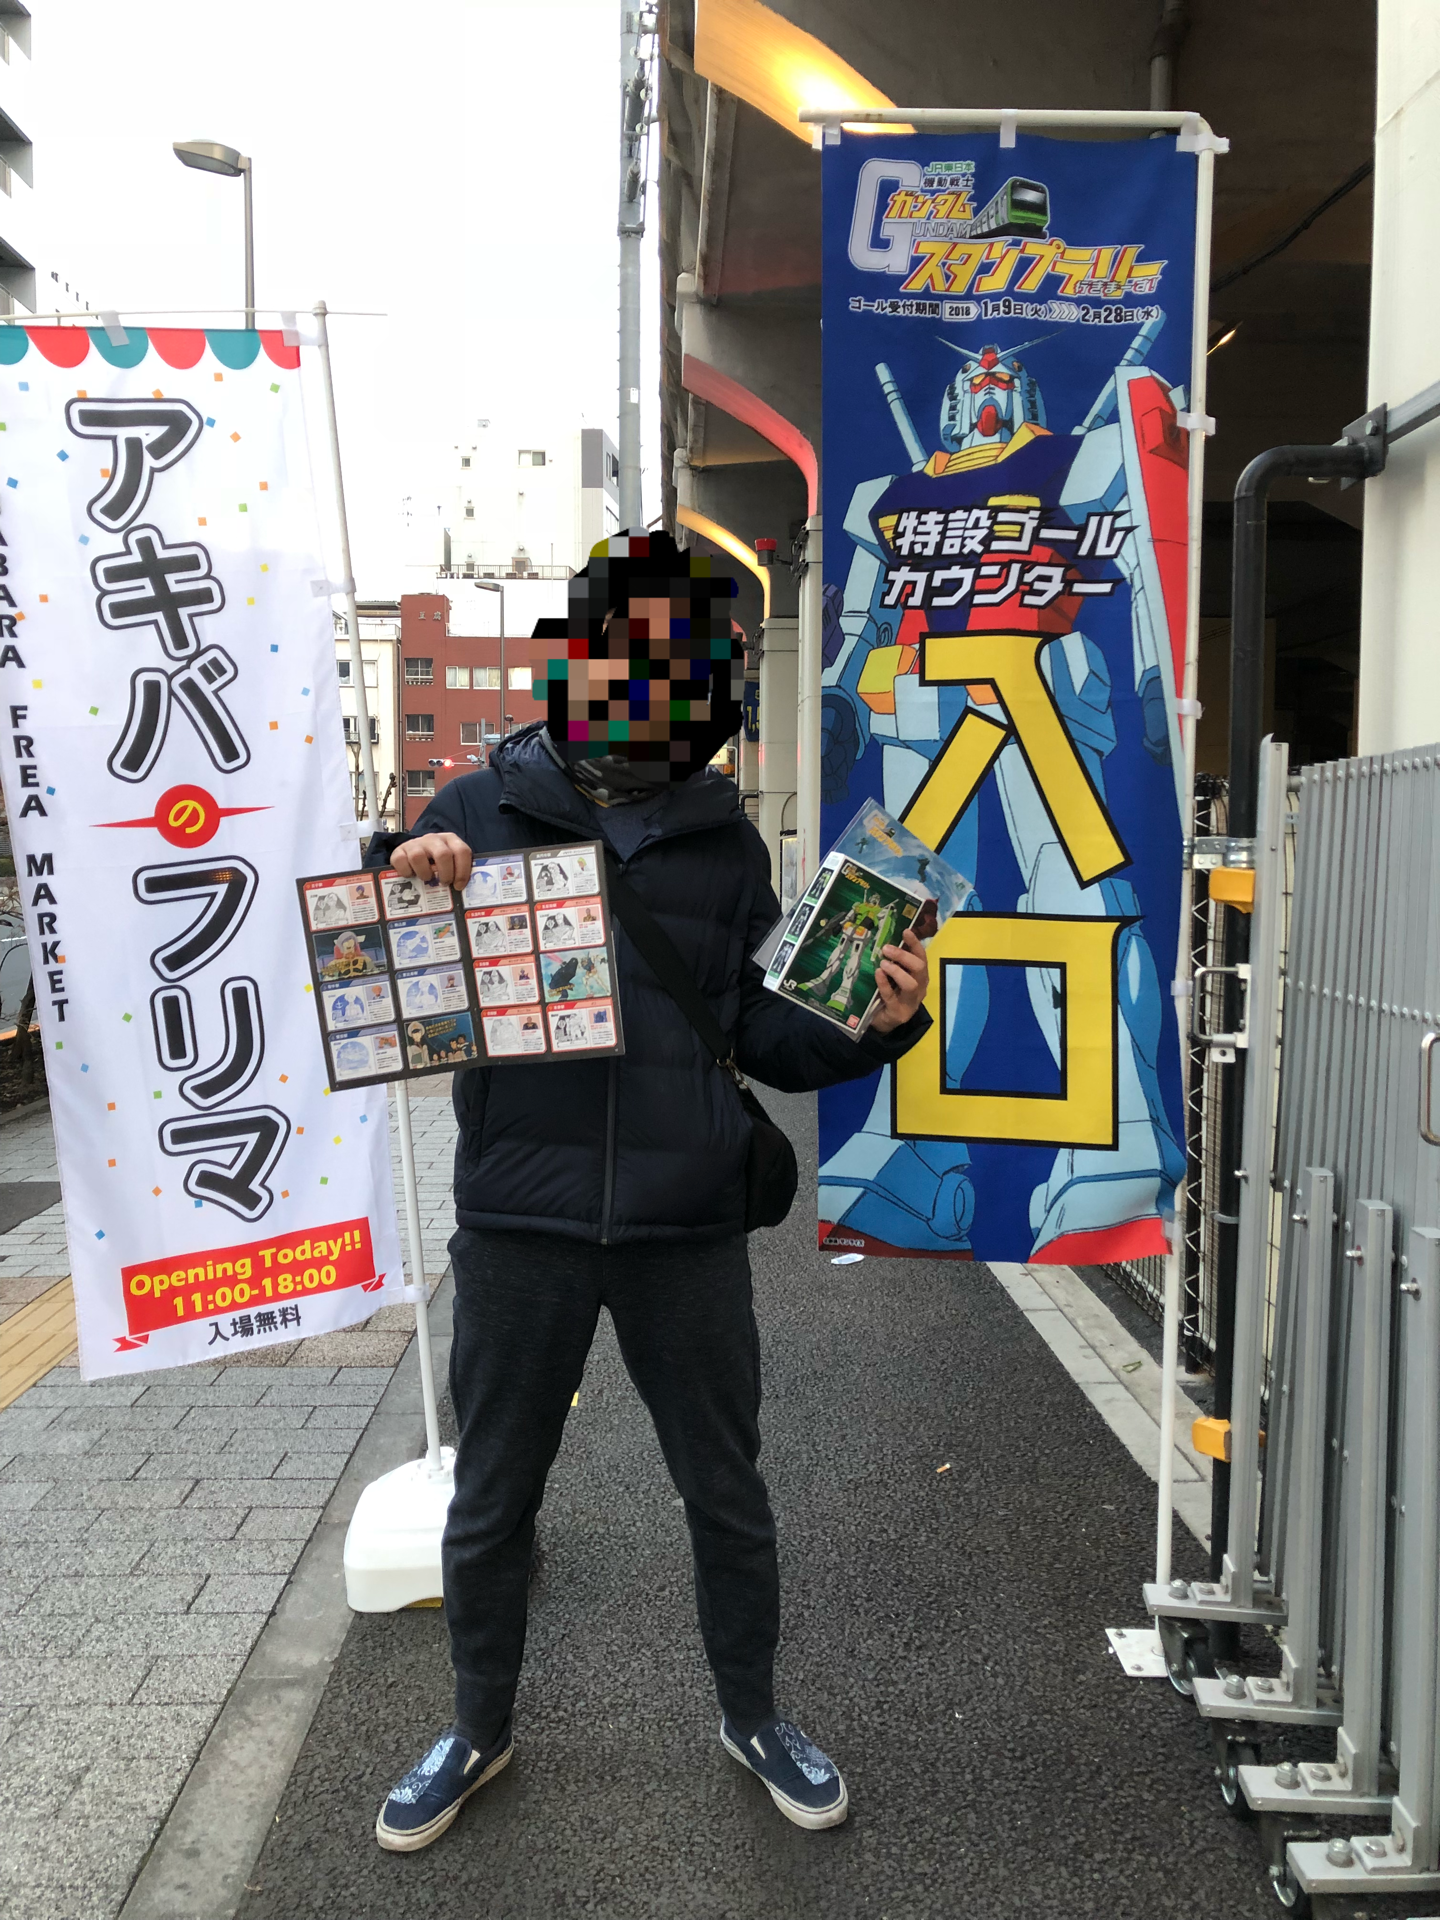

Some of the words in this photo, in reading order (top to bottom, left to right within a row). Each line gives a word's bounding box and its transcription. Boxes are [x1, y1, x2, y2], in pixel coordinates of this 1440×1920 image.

[923, 175, 974, 188] 機動戦士
[925, 161, 975, 174] JR東日本
[884, 189, 975, 220] ガンダム
[902, 239, 1166, 297] スタンプラリー
[850, 297, 940, 317] ゴール受付期間
[948, 305, 971, 317] 2018
[982, 299, 1048, 319] 1月9日(火)
[1081, 305, 1161, 323] 2月28日(水)
[895, 507, 1131, 558] 特設ゴール
[881, 561, 1118, 608] カウンター
[9, 704, 48, 818] FREA
[890, 631, 1144, 1151] 入口
[26, 852, 69, 1023] MARKET
[129, 1256, 252, 1298] Opening
[258, 1229, 362, 1269] Today!!
[173, 1264, 337, 1317] 11:00-18:00
[208, 1304, 301, 1346] 入場無料
